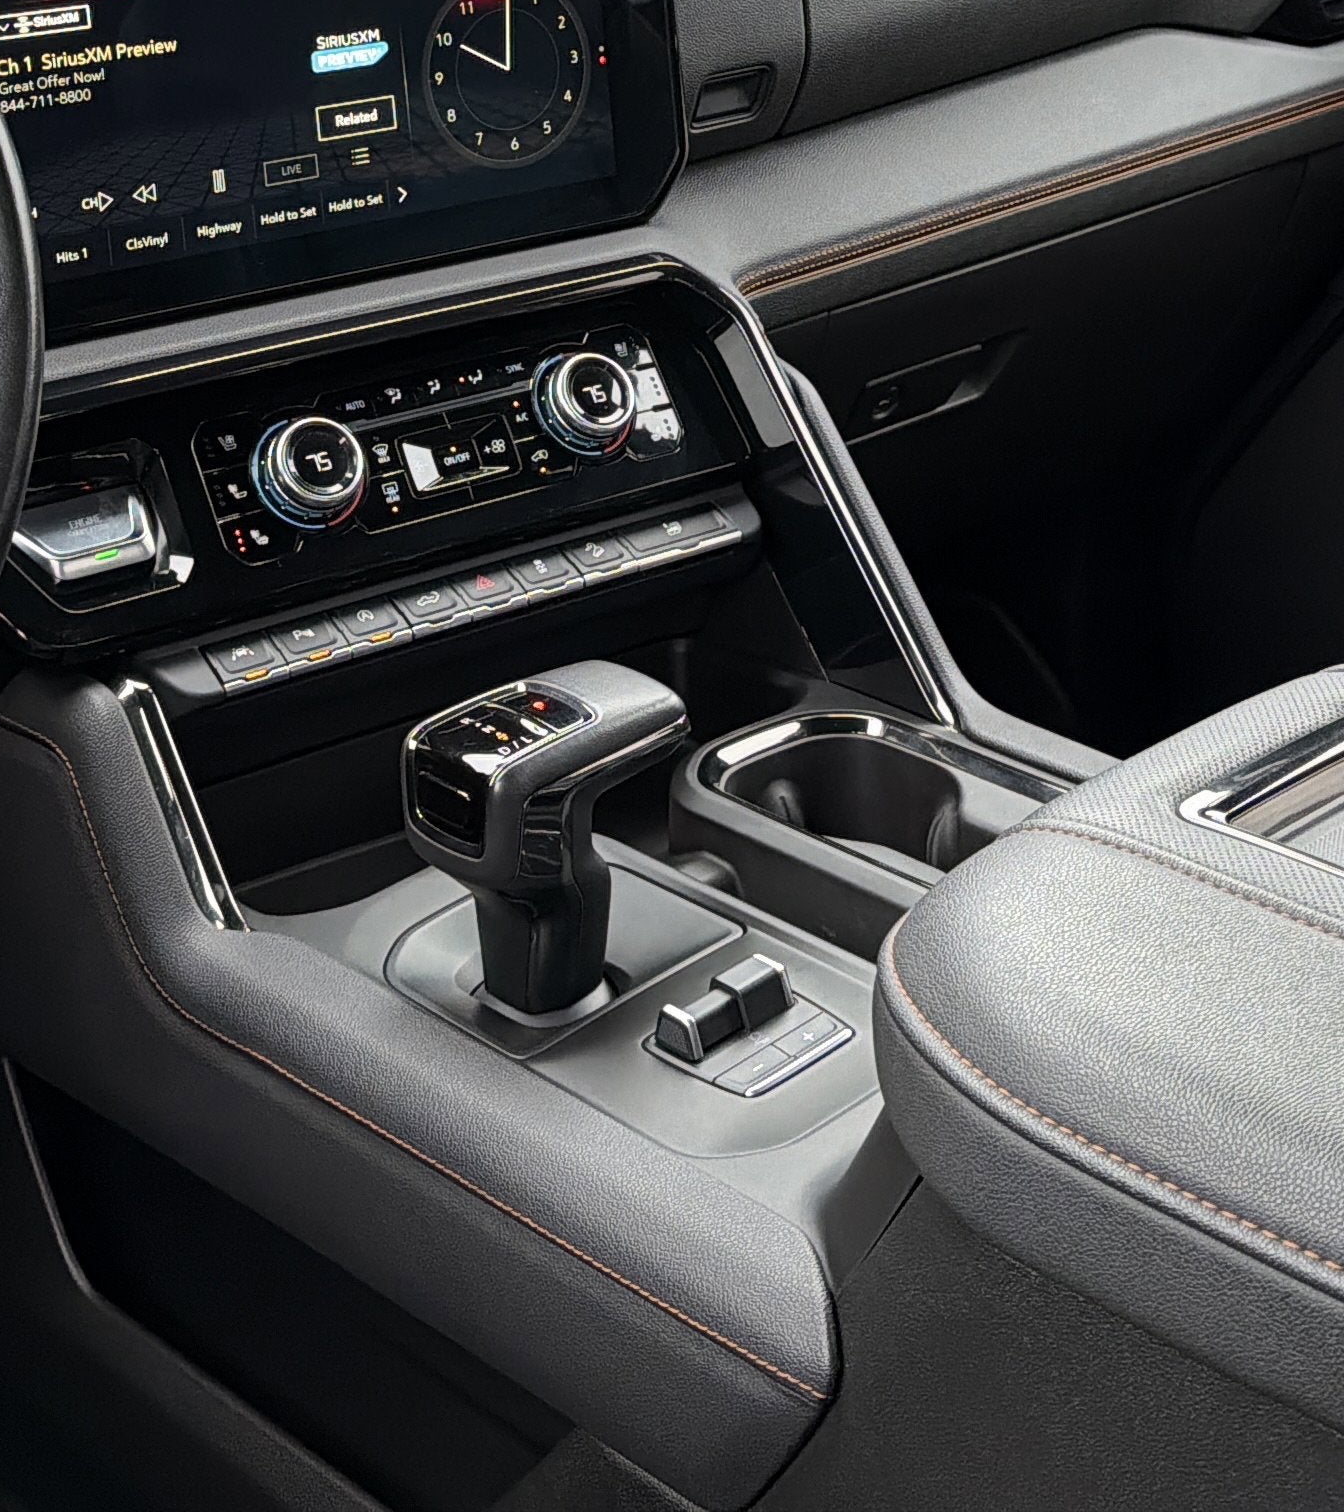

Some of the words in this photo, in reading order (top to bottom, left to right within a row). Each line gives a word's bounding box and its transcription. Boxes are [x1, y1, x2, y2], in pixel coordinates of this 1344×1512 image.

[459, 1, 475, 16] 11
[33, 11, 79, 28] SiriusXM
[557, 15, 567, 30] 2
[316, 29, 380, 50] SIRIUSXM
[436, 32, 453, 47] 10
[24, 56, 33, 73] 1
[41, 45, 112, 70] SiriusXM
[116, 39, 177, 60] Preview
[570, 50, 579, 64] 3
[37, 75, 70, 90] Offer
[73, 68, 105, 84] Now!
[434, 71, 444, 86] 9
[0, 88, 91, 113] 844-711-8800
[563, 89, 573, 102] 4
[335, 108, 378, 128] Related
[446, 108, 457, 123] 8
[542, 120, 552, 135] 5
[474, 131, 484, 146] 7
[510, 137, 520, 150] 6
[281, 163, 303, 176] LIVE
[81, 197, 99, 210] CH
[328, 198, 353, 213] Hold
[354, 198, 366, 208] to
[367, 193, 384, 205] Set
[260, 210, 285, 226] Hold
[286, 210, 299, 221] to
[300, 206, 317, 218] Set
[196, 221, 243, 239] Highway
[125, 232, 169, 251] ClsVinyl
[56, 249, 80, 264] Hits
[82, 247, 89, 259] 1
[581, 384, 607, 404] 75
[345, 399, 366, 411] AUTO
[305, 451, 333, 472] 75
[443, 451, 472, 467] ON/OFF
[68, 513, 103, 529] ENGINE
